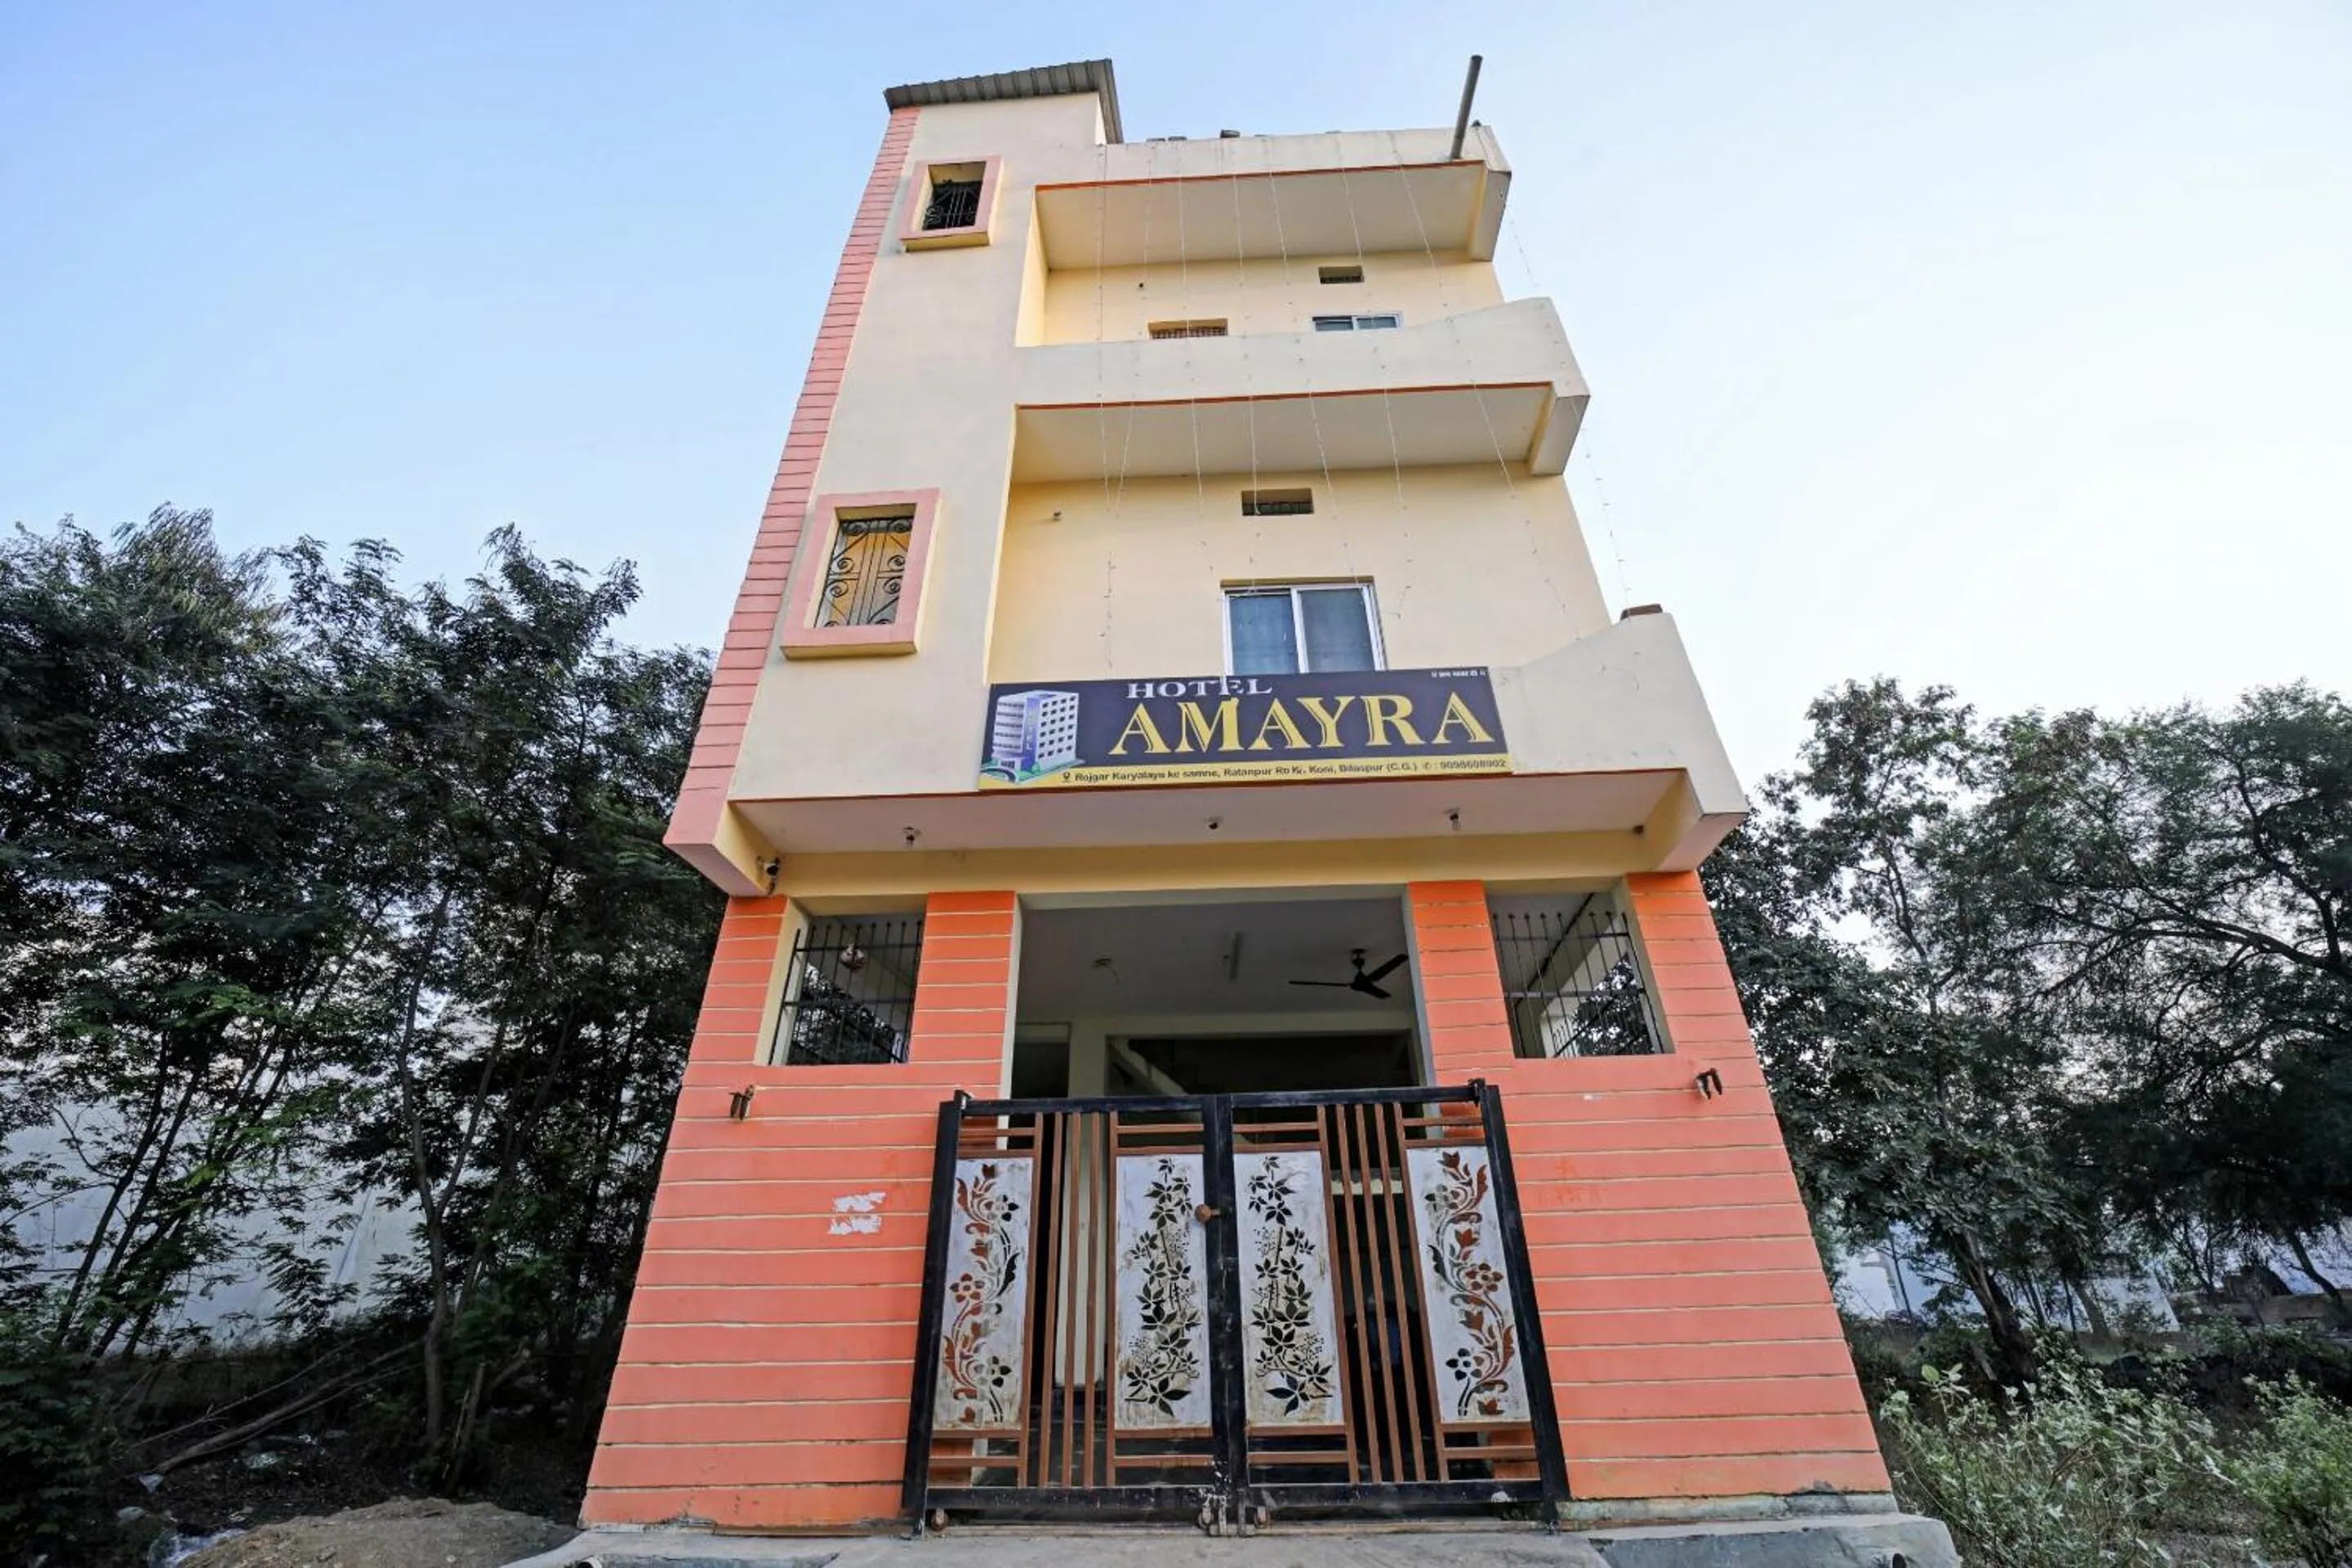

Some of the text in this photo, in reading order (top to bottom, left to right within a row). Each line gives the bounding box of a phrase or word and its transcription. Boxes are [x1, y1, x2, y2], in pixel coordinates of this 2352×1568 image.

[1126, 679, 1272, 698] HOTEL
[1107, 692, 1495, 755] AMAYRA
[1075, 773, 1109, 782] Rojgar
